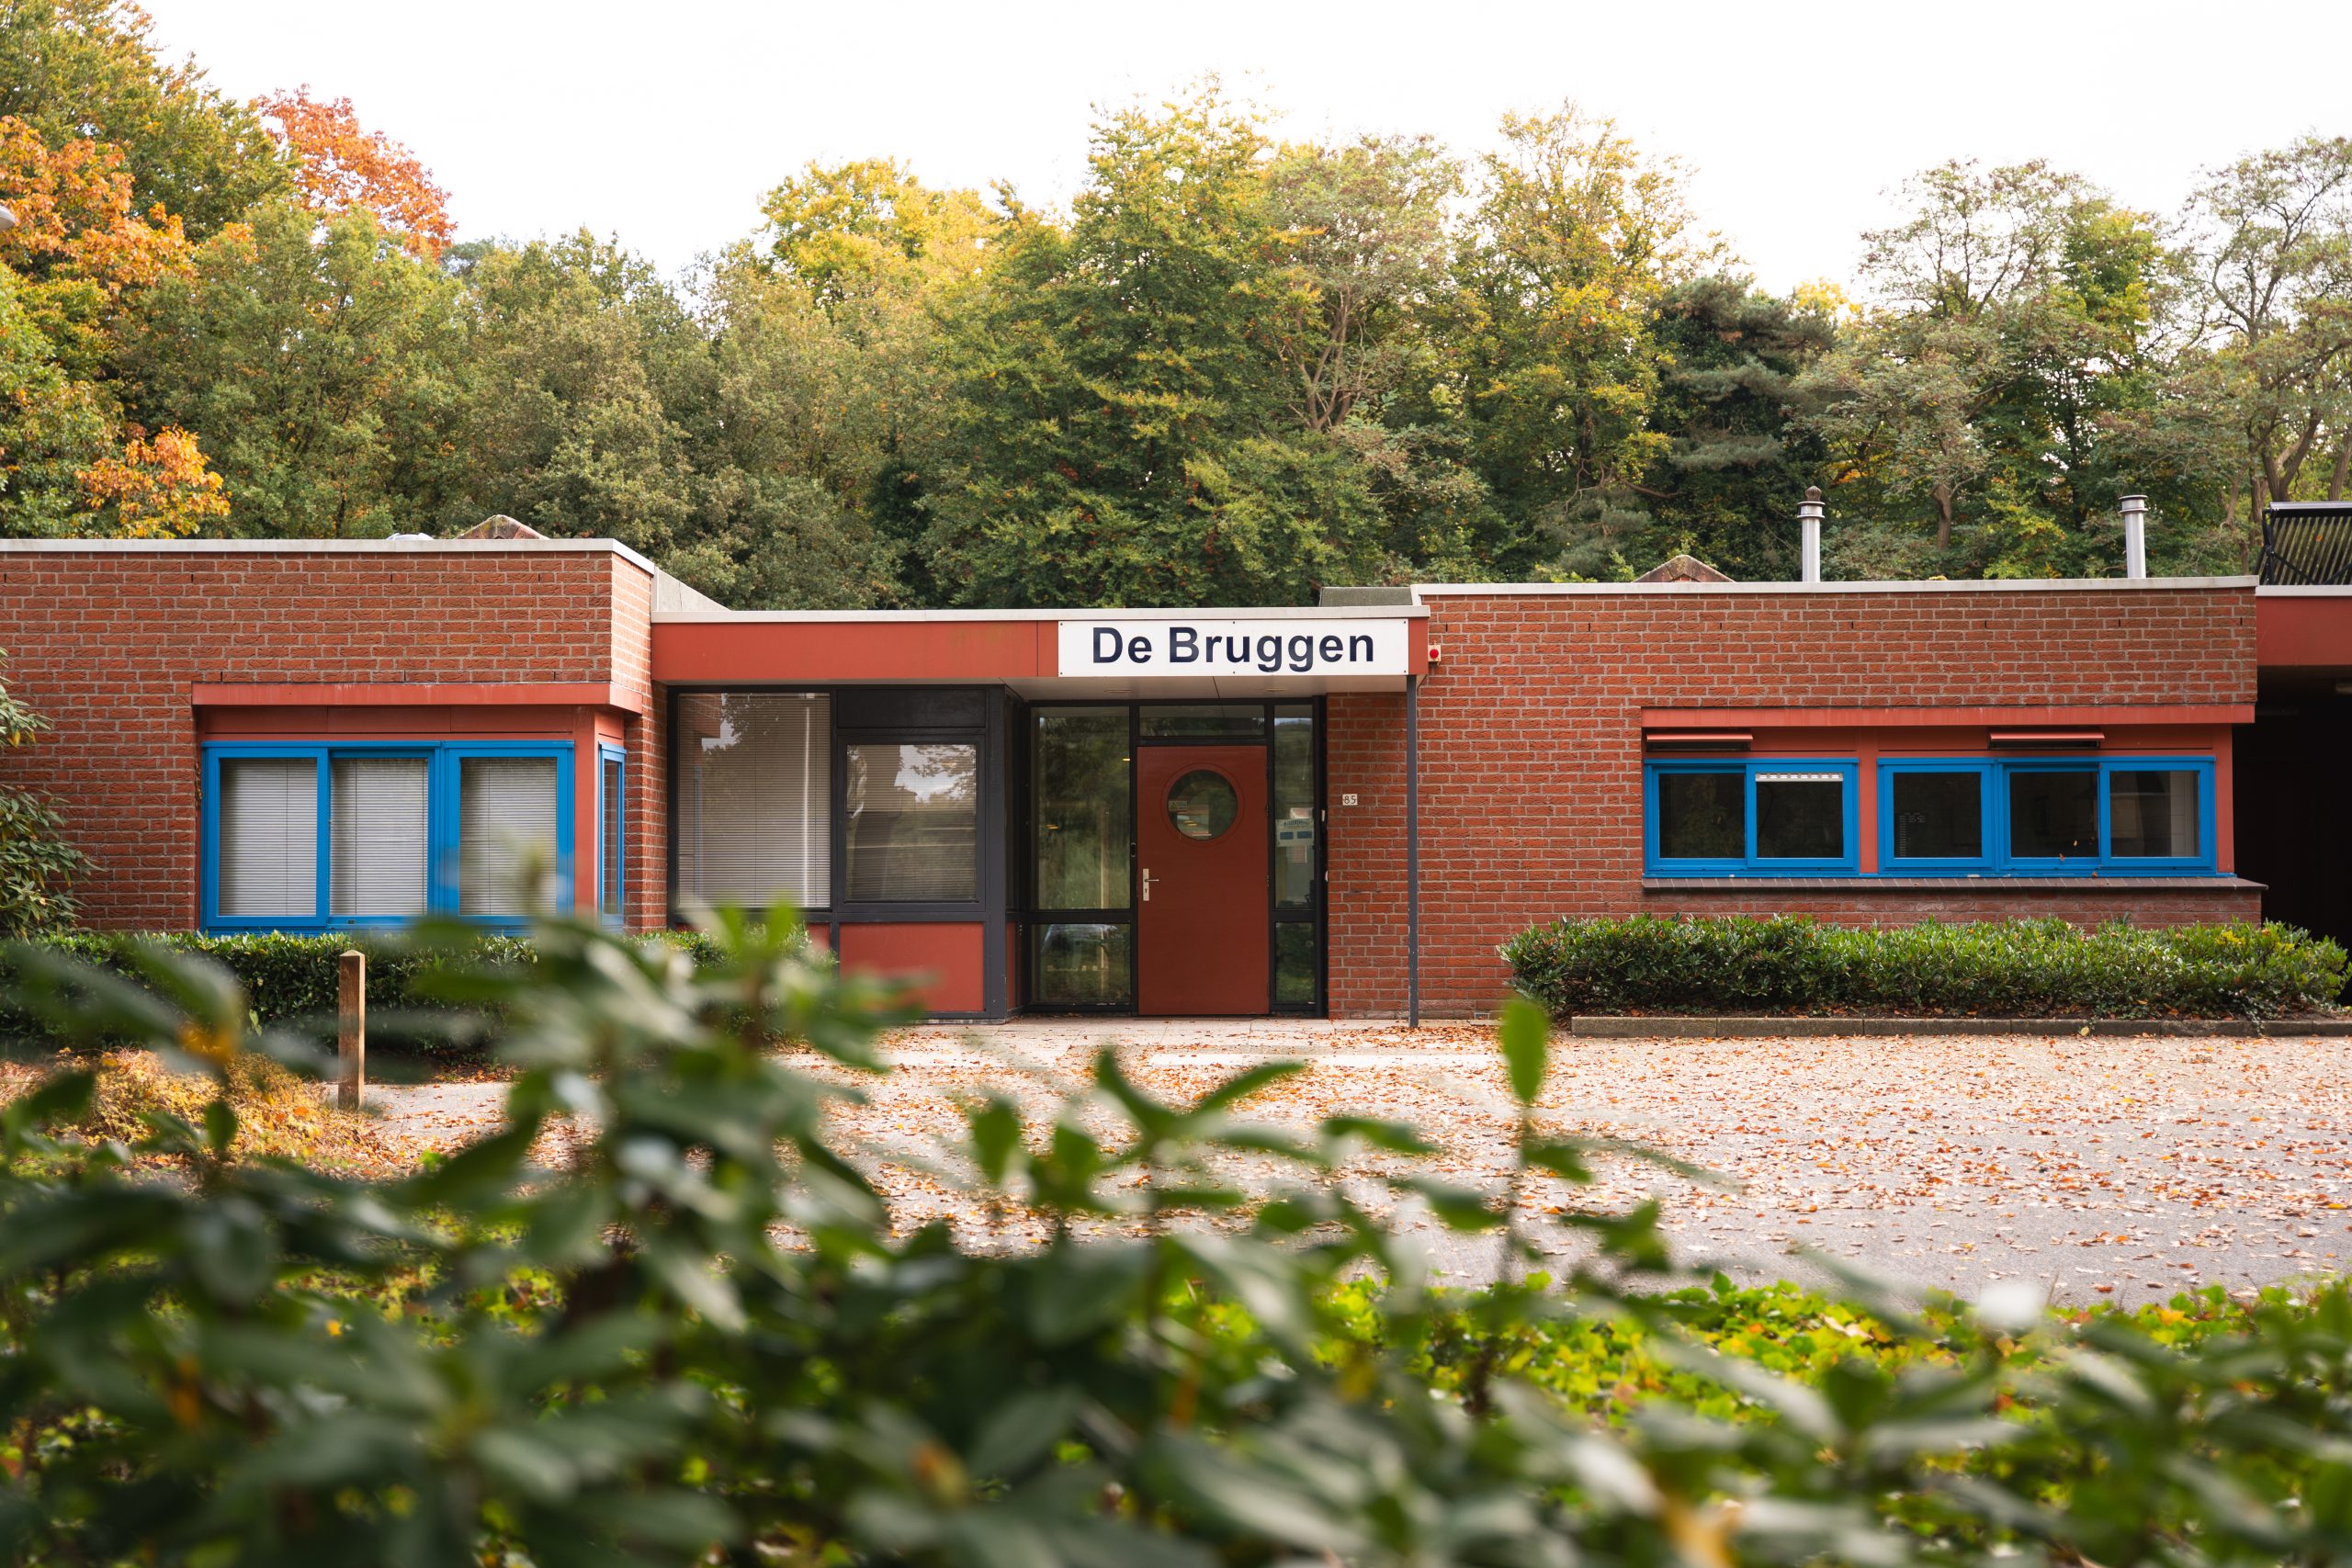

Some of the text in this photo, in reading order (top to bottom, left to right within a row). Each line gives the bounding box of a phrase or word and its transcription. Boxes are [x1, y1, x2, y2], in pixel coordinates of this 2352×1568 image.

[1092, 626, 1374, 673] De Bruggen
[1344, 795, 1356, 805] 85
